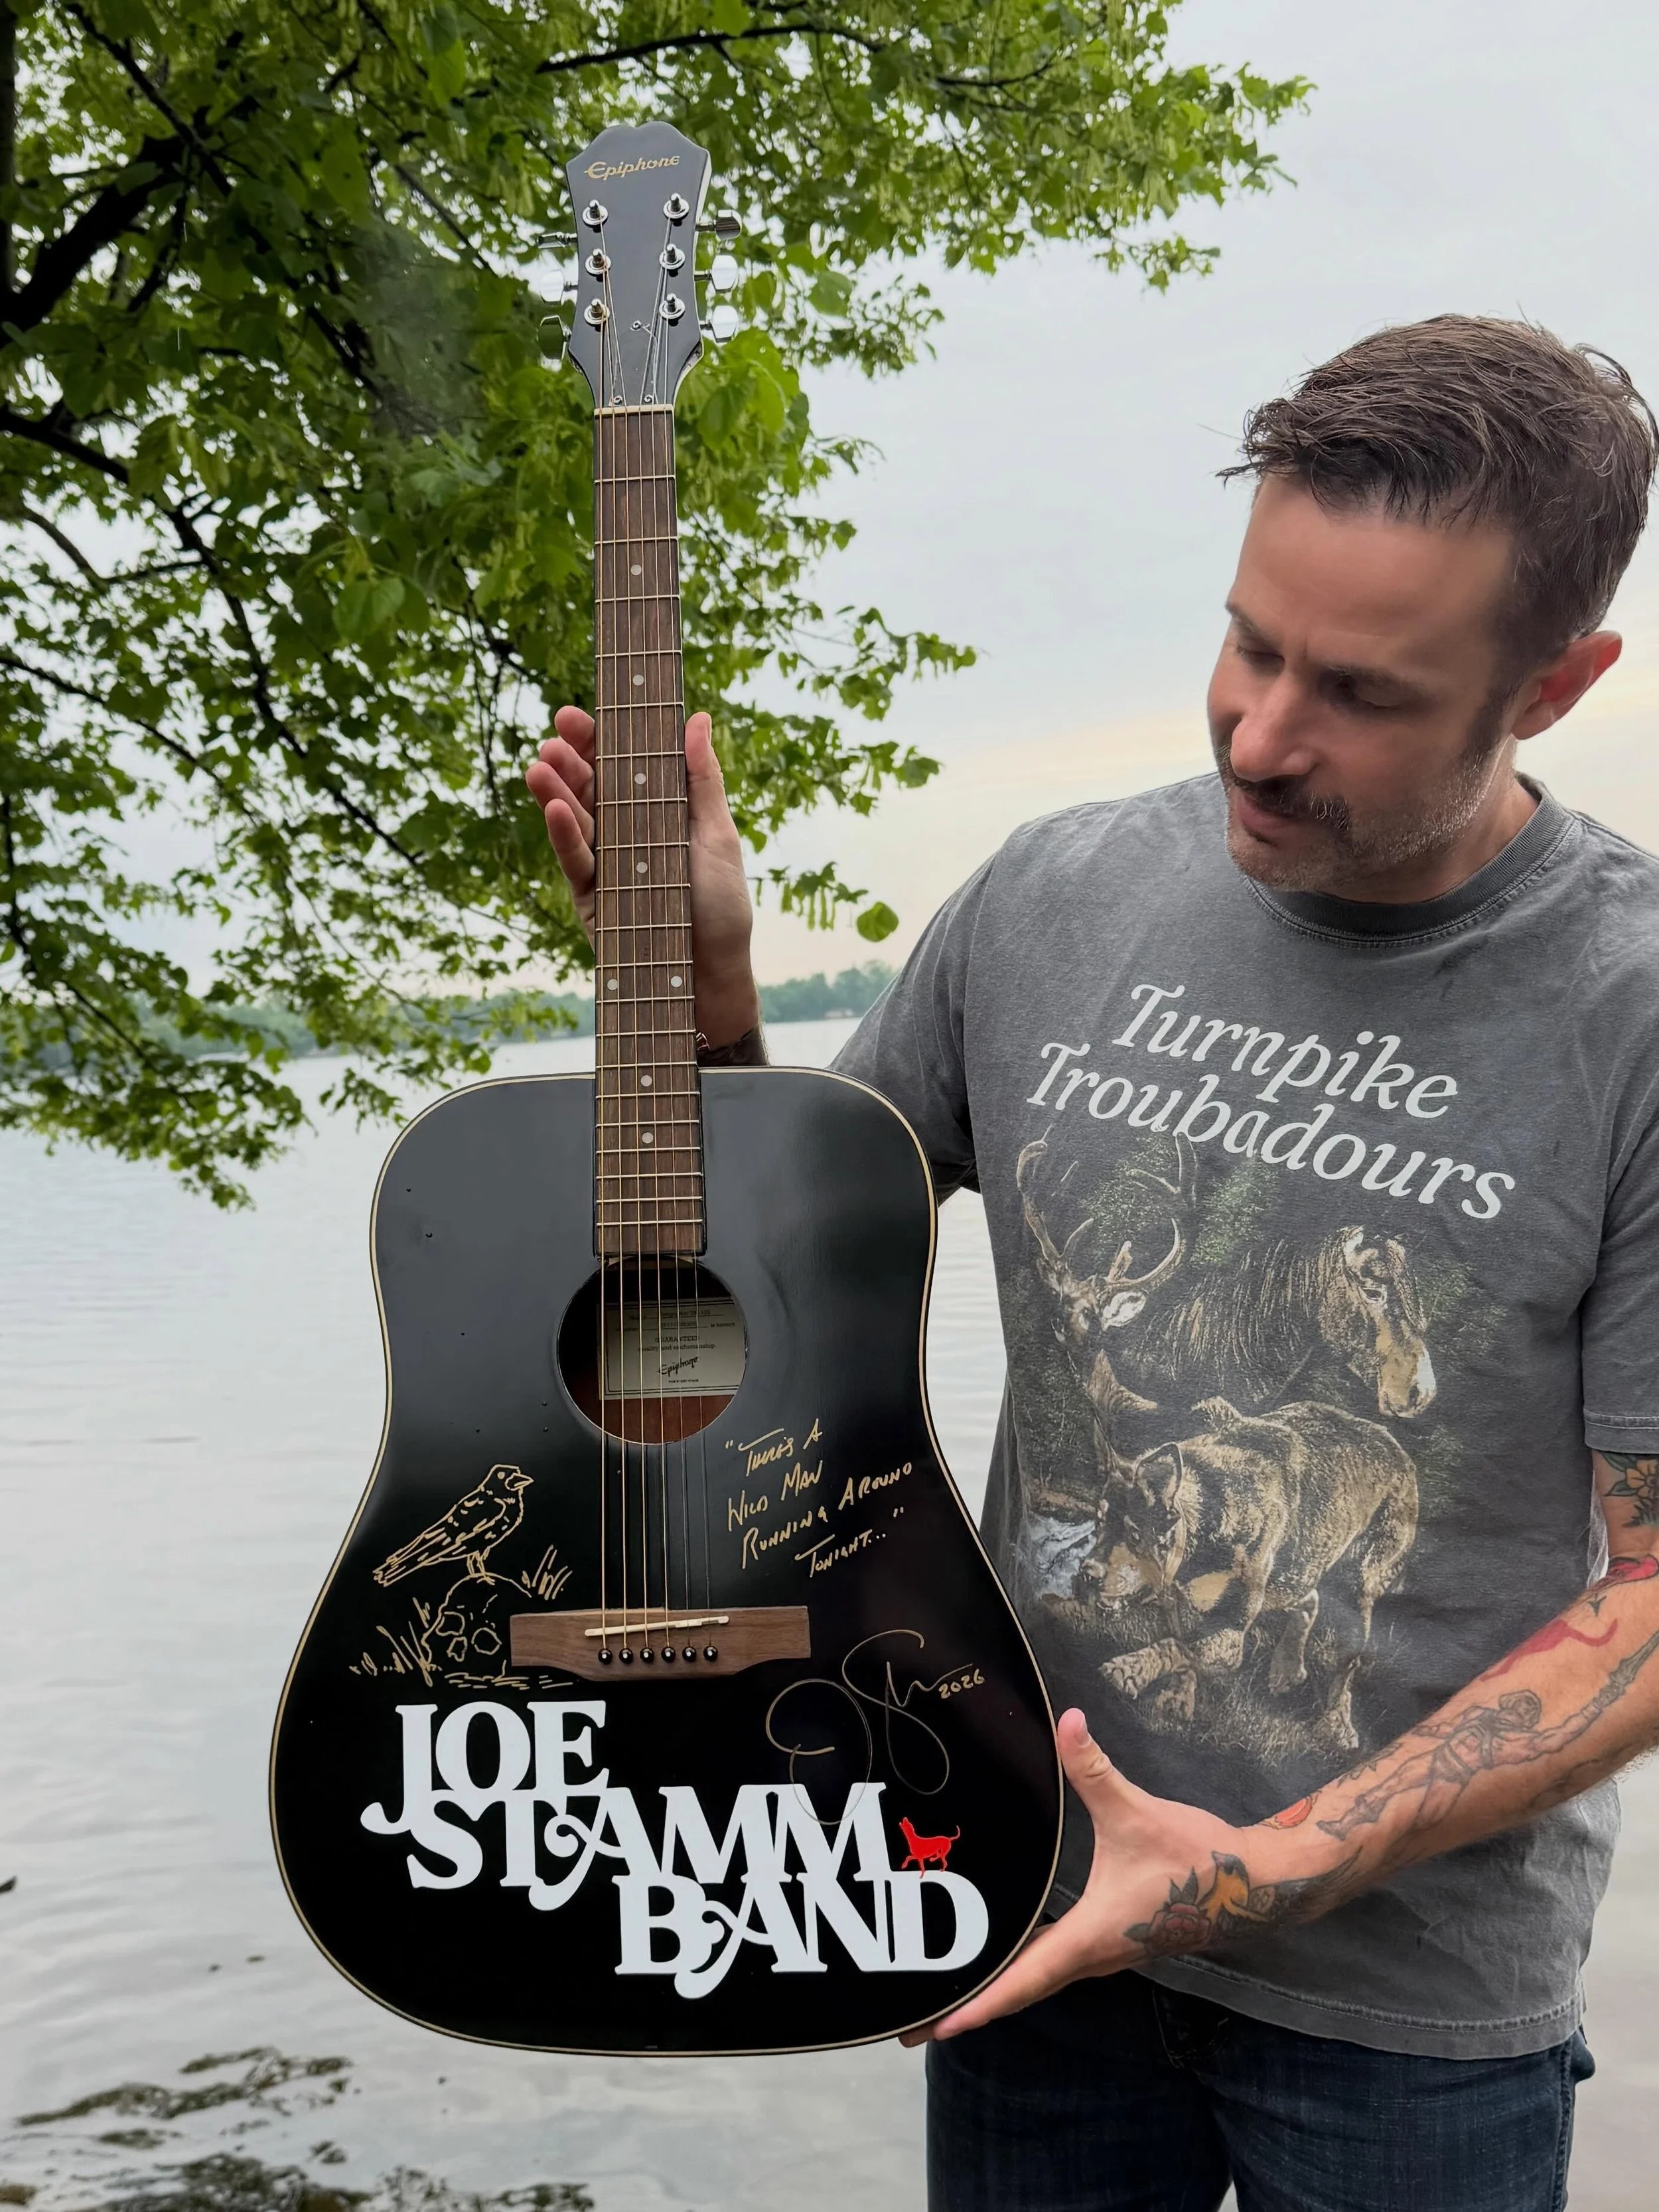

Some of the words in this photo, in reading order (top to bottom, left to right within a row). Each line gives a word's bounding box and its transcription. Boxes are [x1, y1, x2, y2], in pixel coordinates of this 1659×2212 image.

[584, 155, 681, 181] Epiphone
[1112, 983, 1458, 1119] Turnpike
[1026, 1043, 1516, 1220] Troubadours
[780, 1460, 823, 1501] MAN
[803, 1418, 823, 1450] A
[938, 1668, 985, 1700] 2026
[360, 1700, 609, 1835] JOE
[406, 1781, 892, 1911] STAMM
[611, 1870, 989, 2000] BAND
